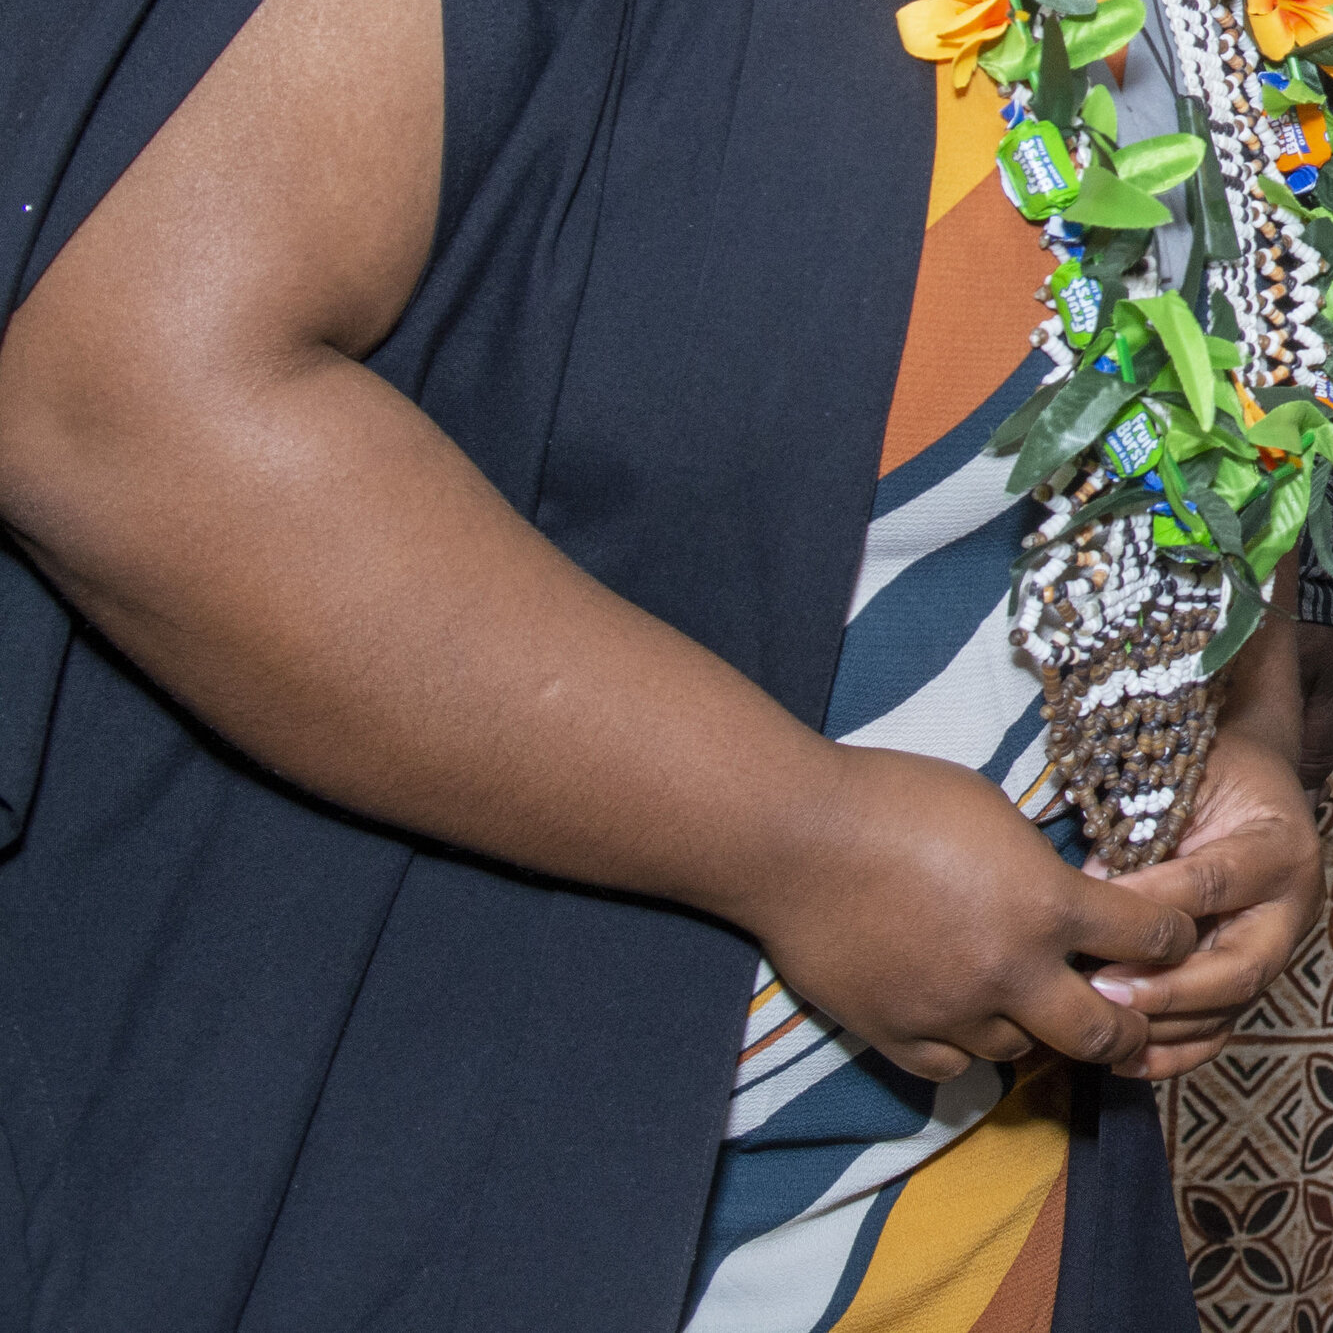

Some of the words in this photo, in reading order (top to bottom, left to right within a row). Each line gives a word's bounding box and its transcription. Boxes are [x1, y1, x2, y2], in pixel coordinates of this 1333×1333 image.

[1035, 138, 1047, 156] Lime
[1280, 113, 1301, 155] Burs
[1012, 149, 1039, 195] Fruit
[1019, 138, 1055, 193] Burst
[1060, 287, 1086, 332] Fruit
[1070, 277, 1098, 333] Burst
[1116, 420, 1148, 470] Burst
[1131, 412, 1159, 455] Fruit
